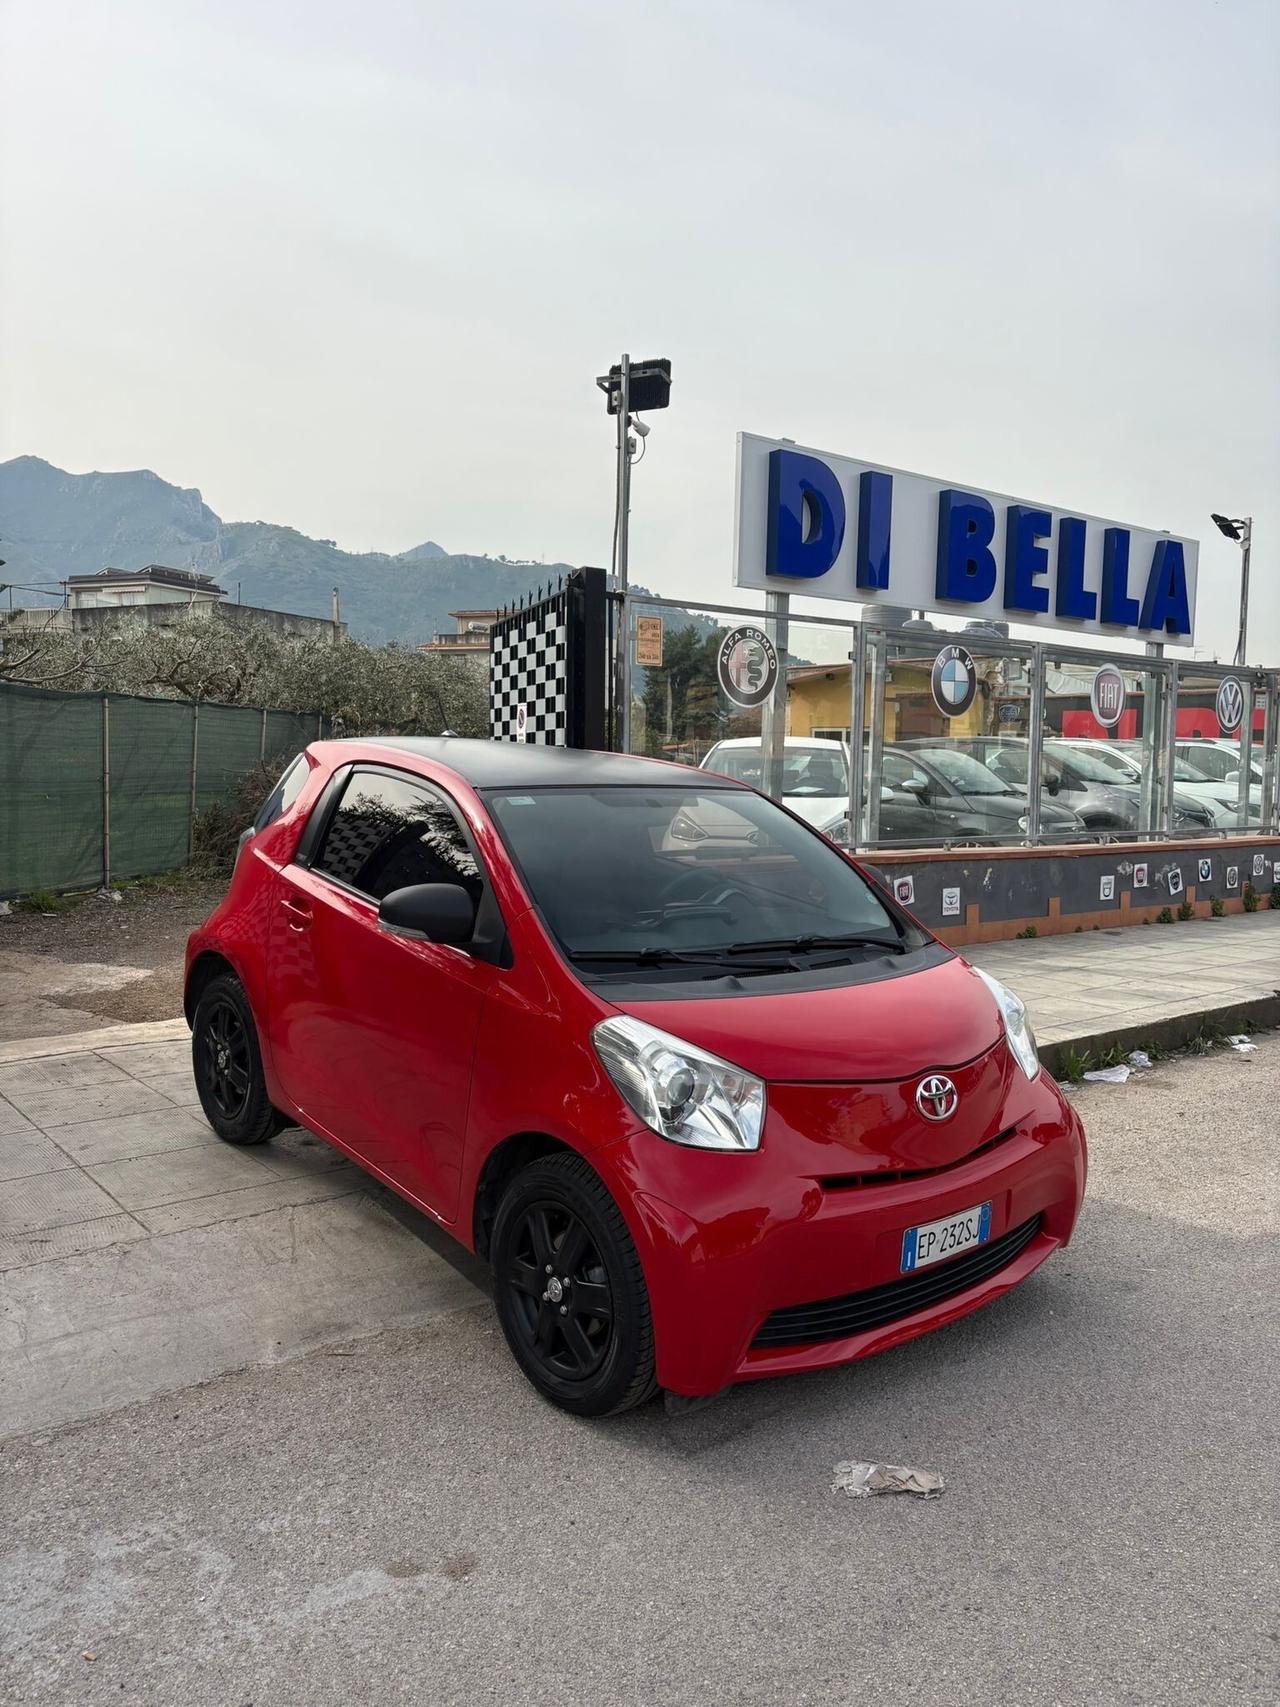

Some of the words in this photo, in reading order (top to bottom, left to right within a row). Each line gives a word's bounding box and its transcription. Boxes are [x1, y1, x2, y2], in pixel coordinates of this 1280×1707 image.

[766, 449, 893, 590] DI
[935, 489, 1191, 634] BELLA
[721, 632, 742, 665] ALFA
[746, 629, 776, 670] ROMEO
[937, 647, 973, 670] BMW
[1100, 682, 1119, 710] FIAT
[917, 1231, 937, 1260] EP
[940, 1214, 981, 1253] 232SJ
